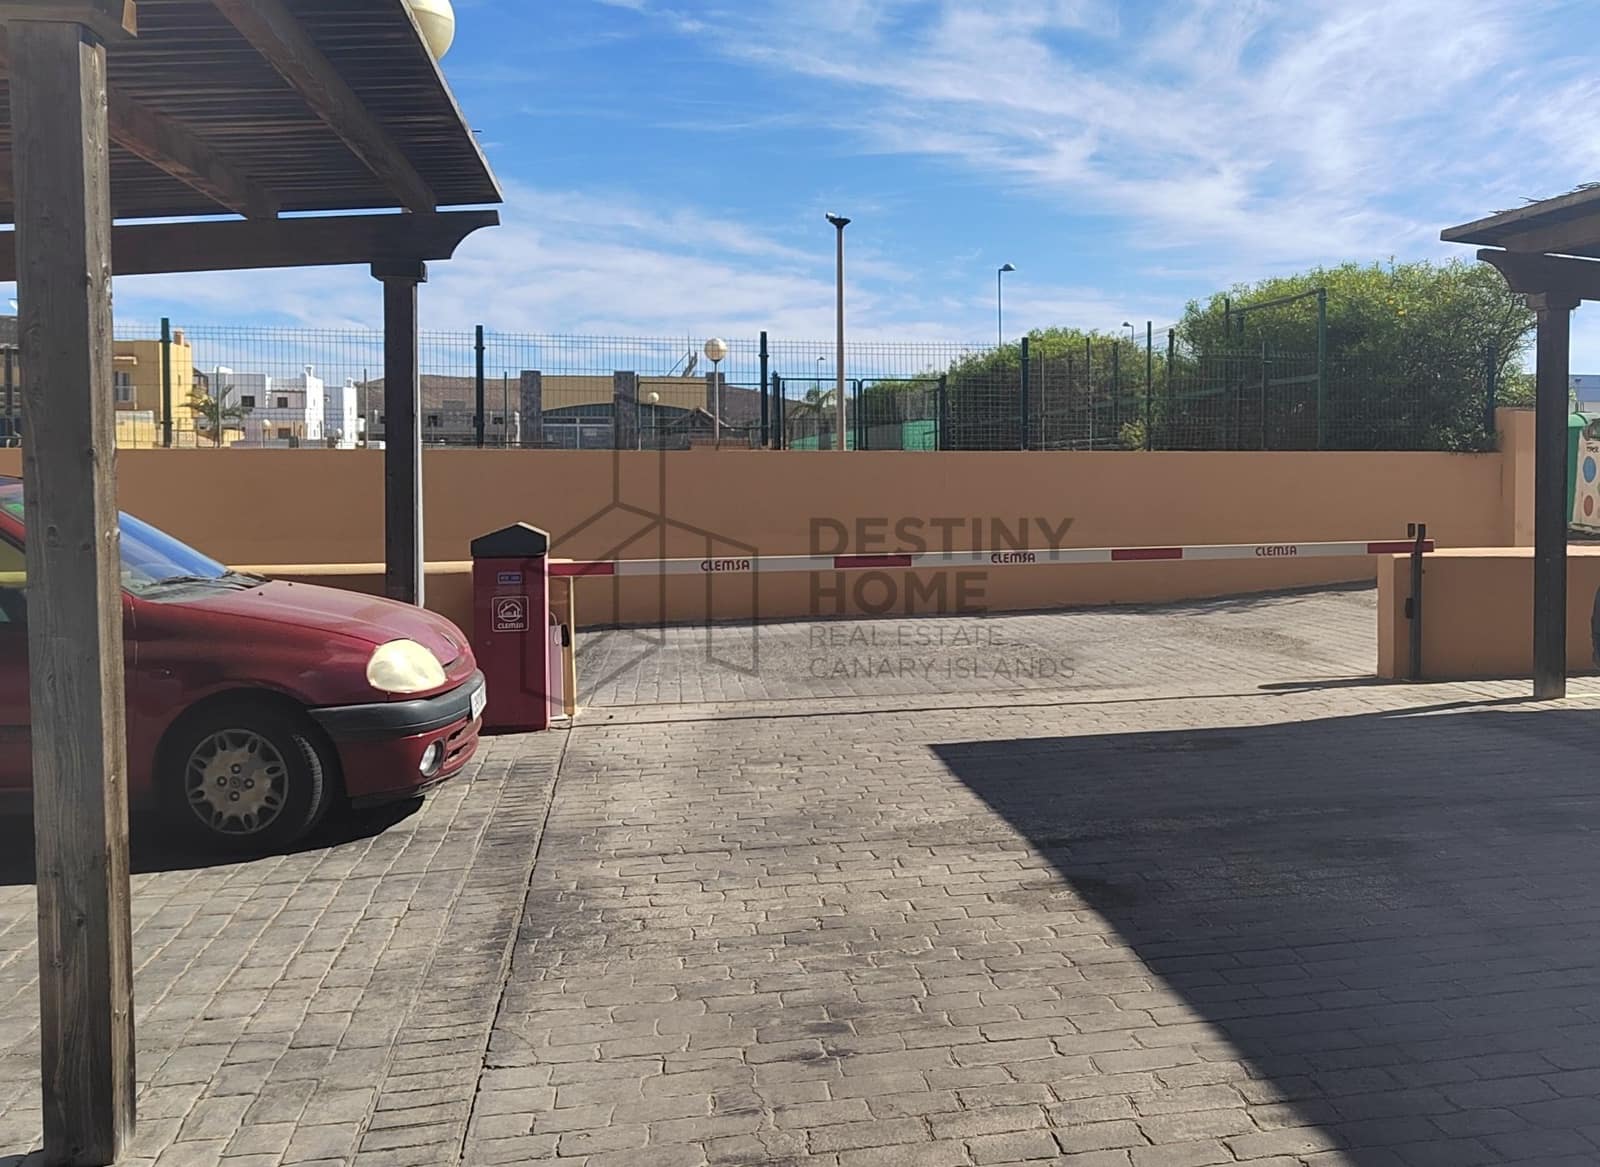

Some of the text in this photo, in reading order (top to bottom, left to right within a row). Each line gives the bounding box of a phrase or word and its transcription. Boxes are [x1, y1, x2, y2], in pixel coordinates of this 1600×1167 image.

[1255, 545, 1297, 556] CLEMSA
[991, 552, 1036, 563] CLEMSA
[700, 560, 750, 571] CLEMSA
